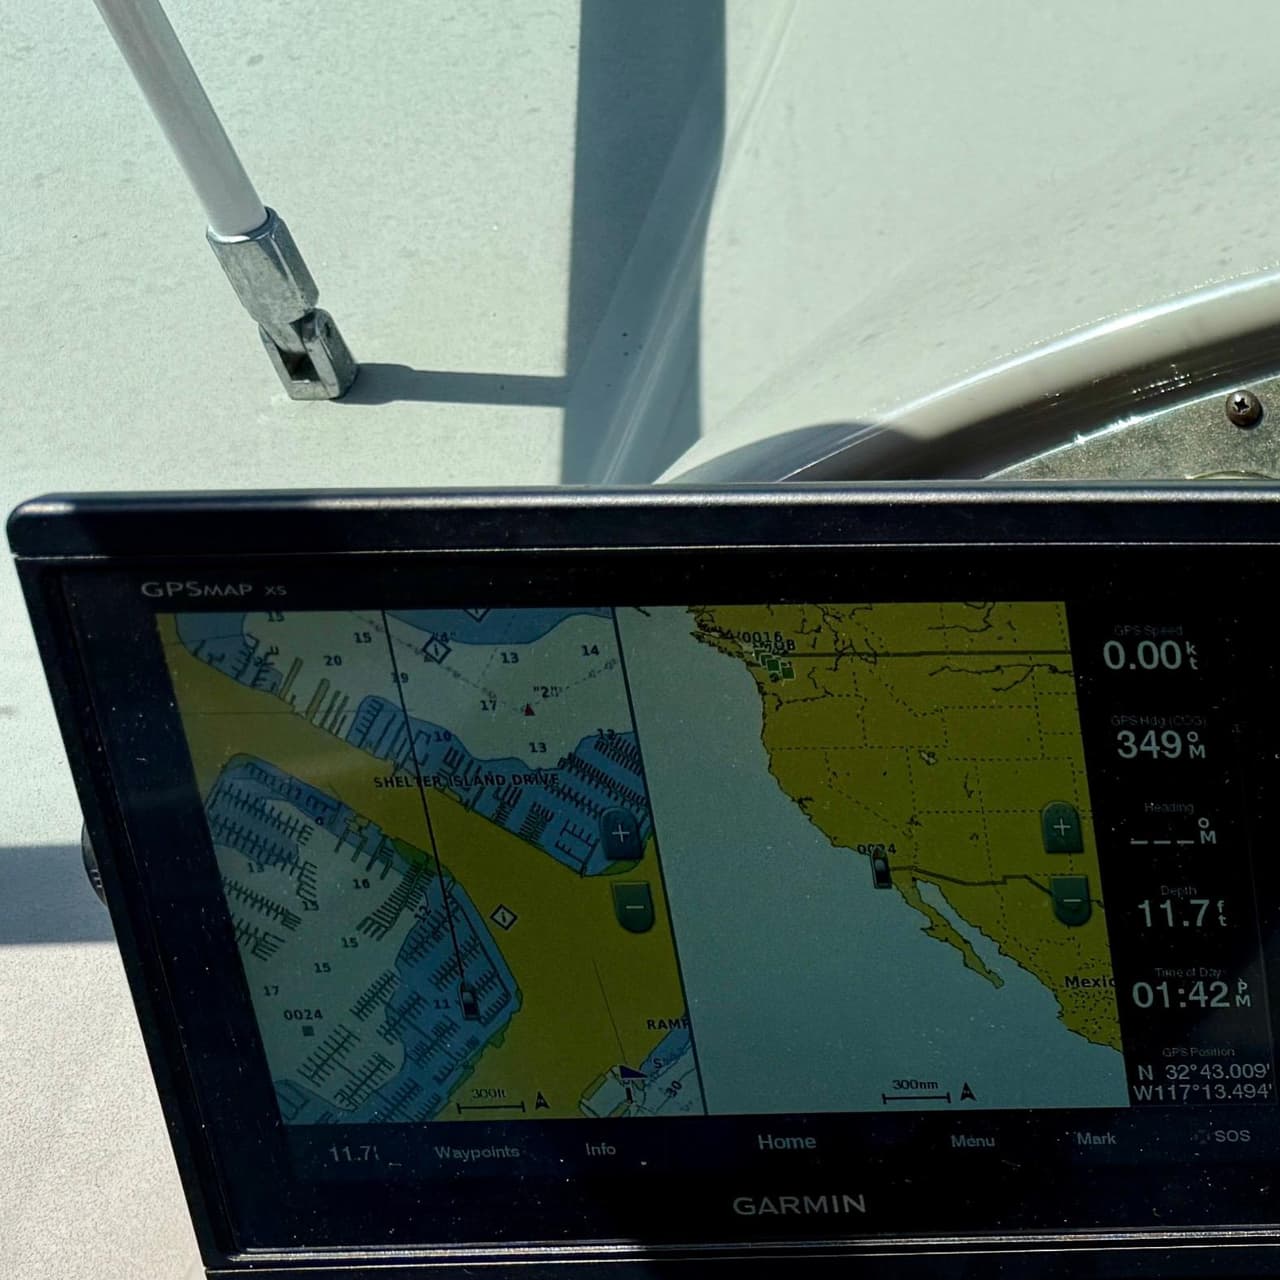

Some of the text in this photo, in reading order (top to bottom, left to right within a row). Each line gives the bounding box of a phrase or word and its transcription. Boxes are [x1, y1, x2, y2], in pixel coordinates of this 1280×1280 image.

[141, 581, 252, 598] GPSMAP
[1103, 641, 1182, 670] 0.00
[1117, 731, 1182, 759] 349
[1138, 900, 1209, 927] 11.7
[1133, 982, 1230, 1009] 01:42
[1139, 1064, 1153, 1080] N
[757, 1133, 816, 1150] Home
[952, 1134, 995, 1149] Menu
[1077, 1131, 1116, 1146] Mark
[1215, 1129, 1250, 1143] SOS
[435, 1145, 520, 1160] Waypoints
[585, 1143, 616, 1156] Info
[732, 1195, 867, 1216] GARMIN
